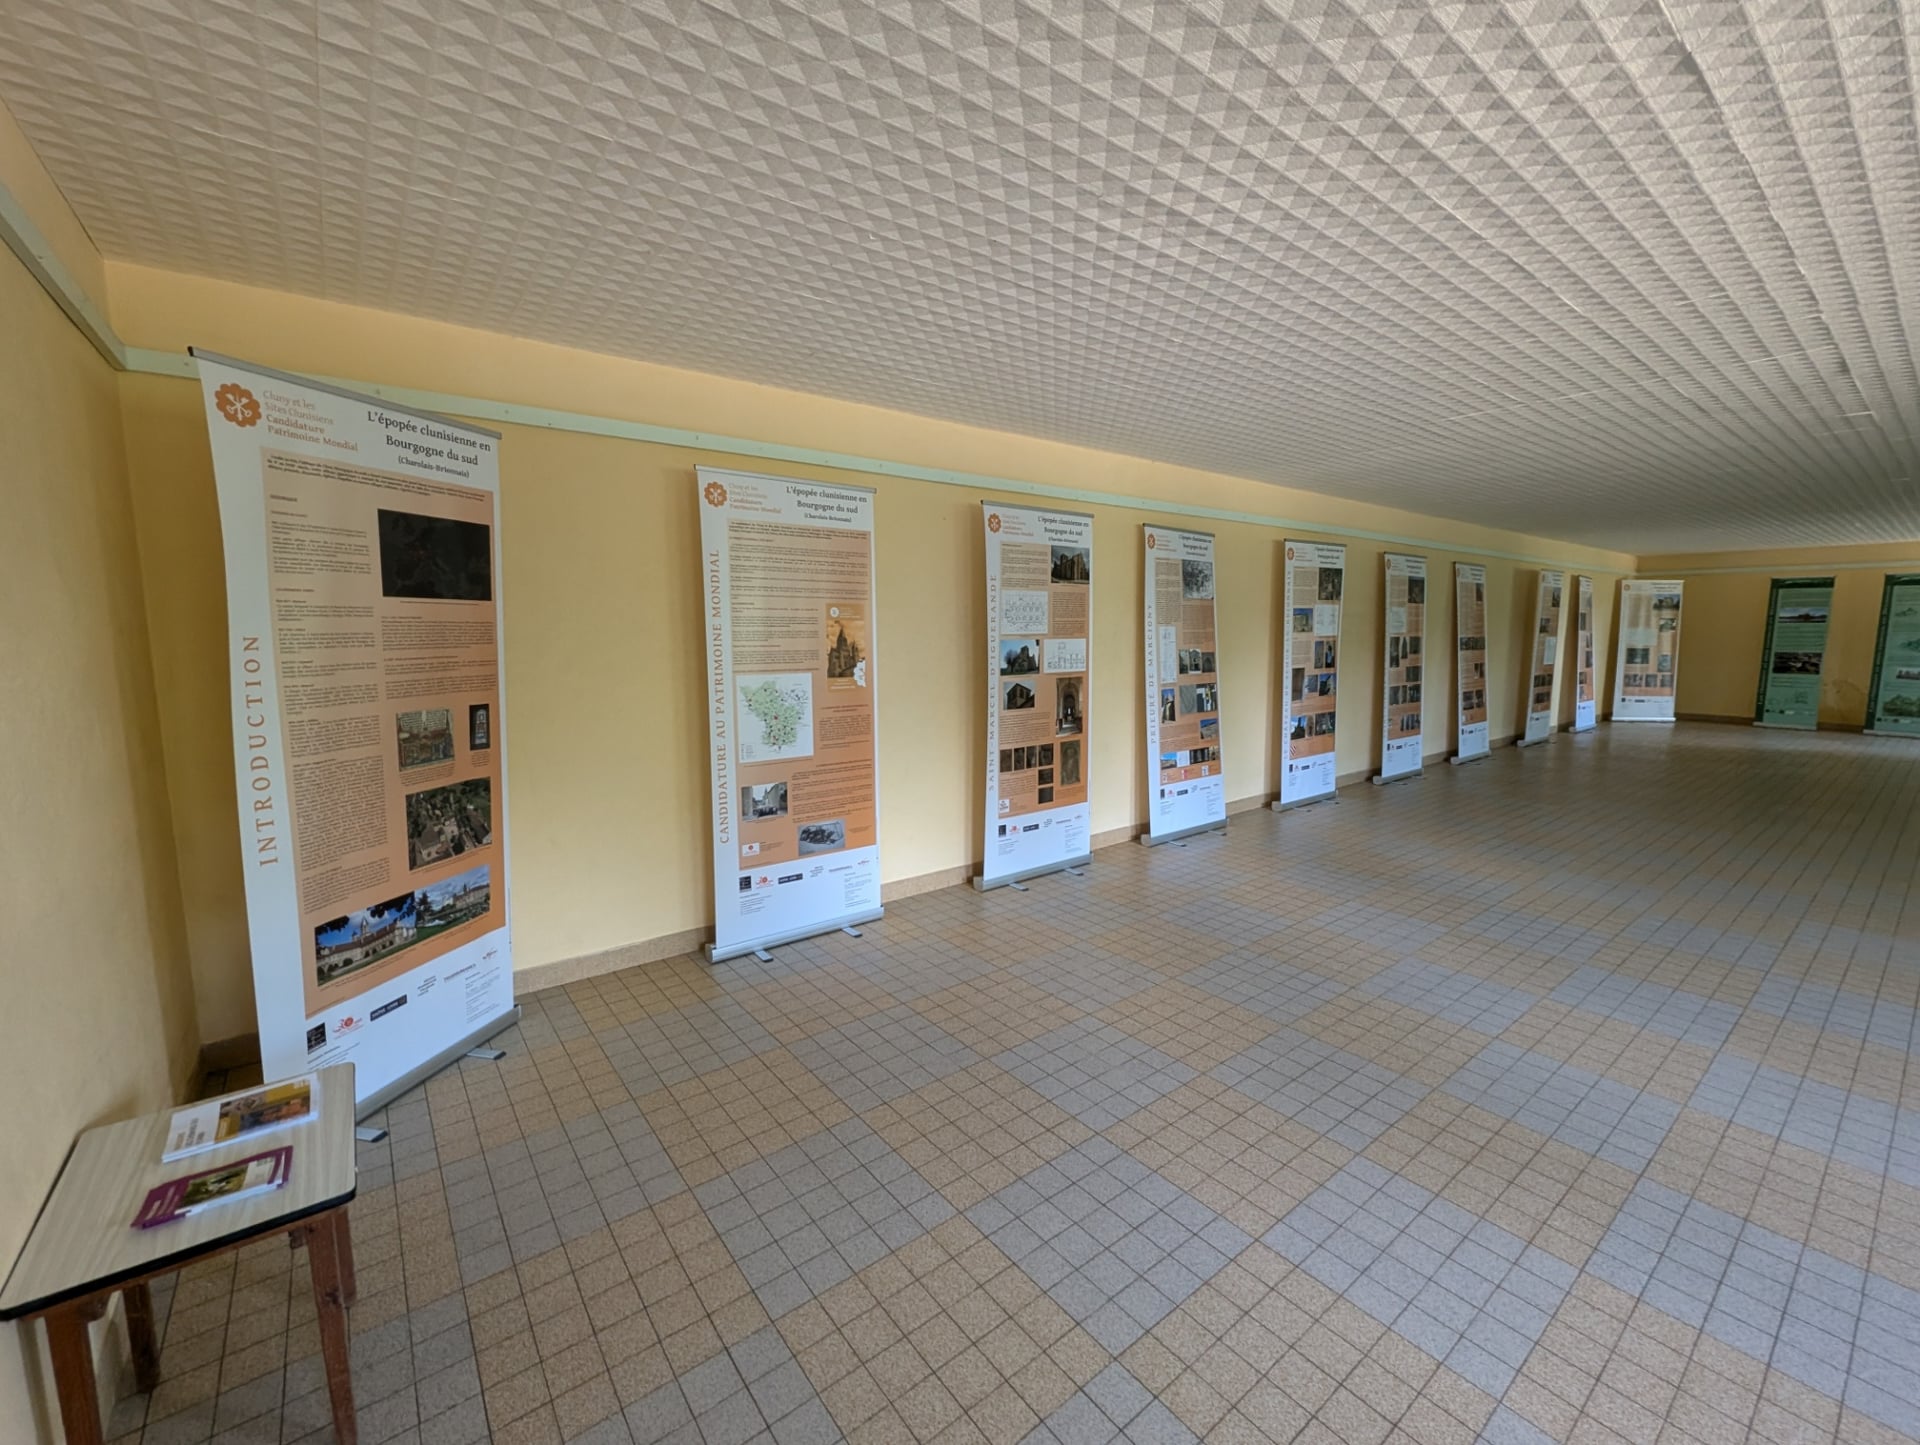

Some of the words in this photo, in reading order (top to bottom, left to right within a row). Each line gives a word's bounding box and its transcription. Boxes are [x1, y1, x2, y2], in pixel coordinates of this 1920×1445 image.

[266, 414, 325, 434] Candidature
[267, 424, 320, 443] Patrimoine
[323, 436, 358, 452] Mondial
[367, 410, 418, 432] L'épopée
[420, 424, 477, 449] clunisienne
[479, 442, 491, 452] en
[386, 434, 444, 458] Bourgogne
[447, 448, 459, 461] du
[461, 454, 479, 466] sud
[797, 500, 835, 512] Bourgogne
[836, 504, 845, 512] du
[846, 506, 858, 514] sud
[709, 549, 722, 618] MONDIAL
[712, 623, 725, 714] PATRIMOINE
[715, 720, 726, 739] AU
[988, 686, 996, 792] SAINT-MARCEL
[243, 636, 279, 867] INTRODUCTION
[717, 743, 729, 844] CANDIDATURE
